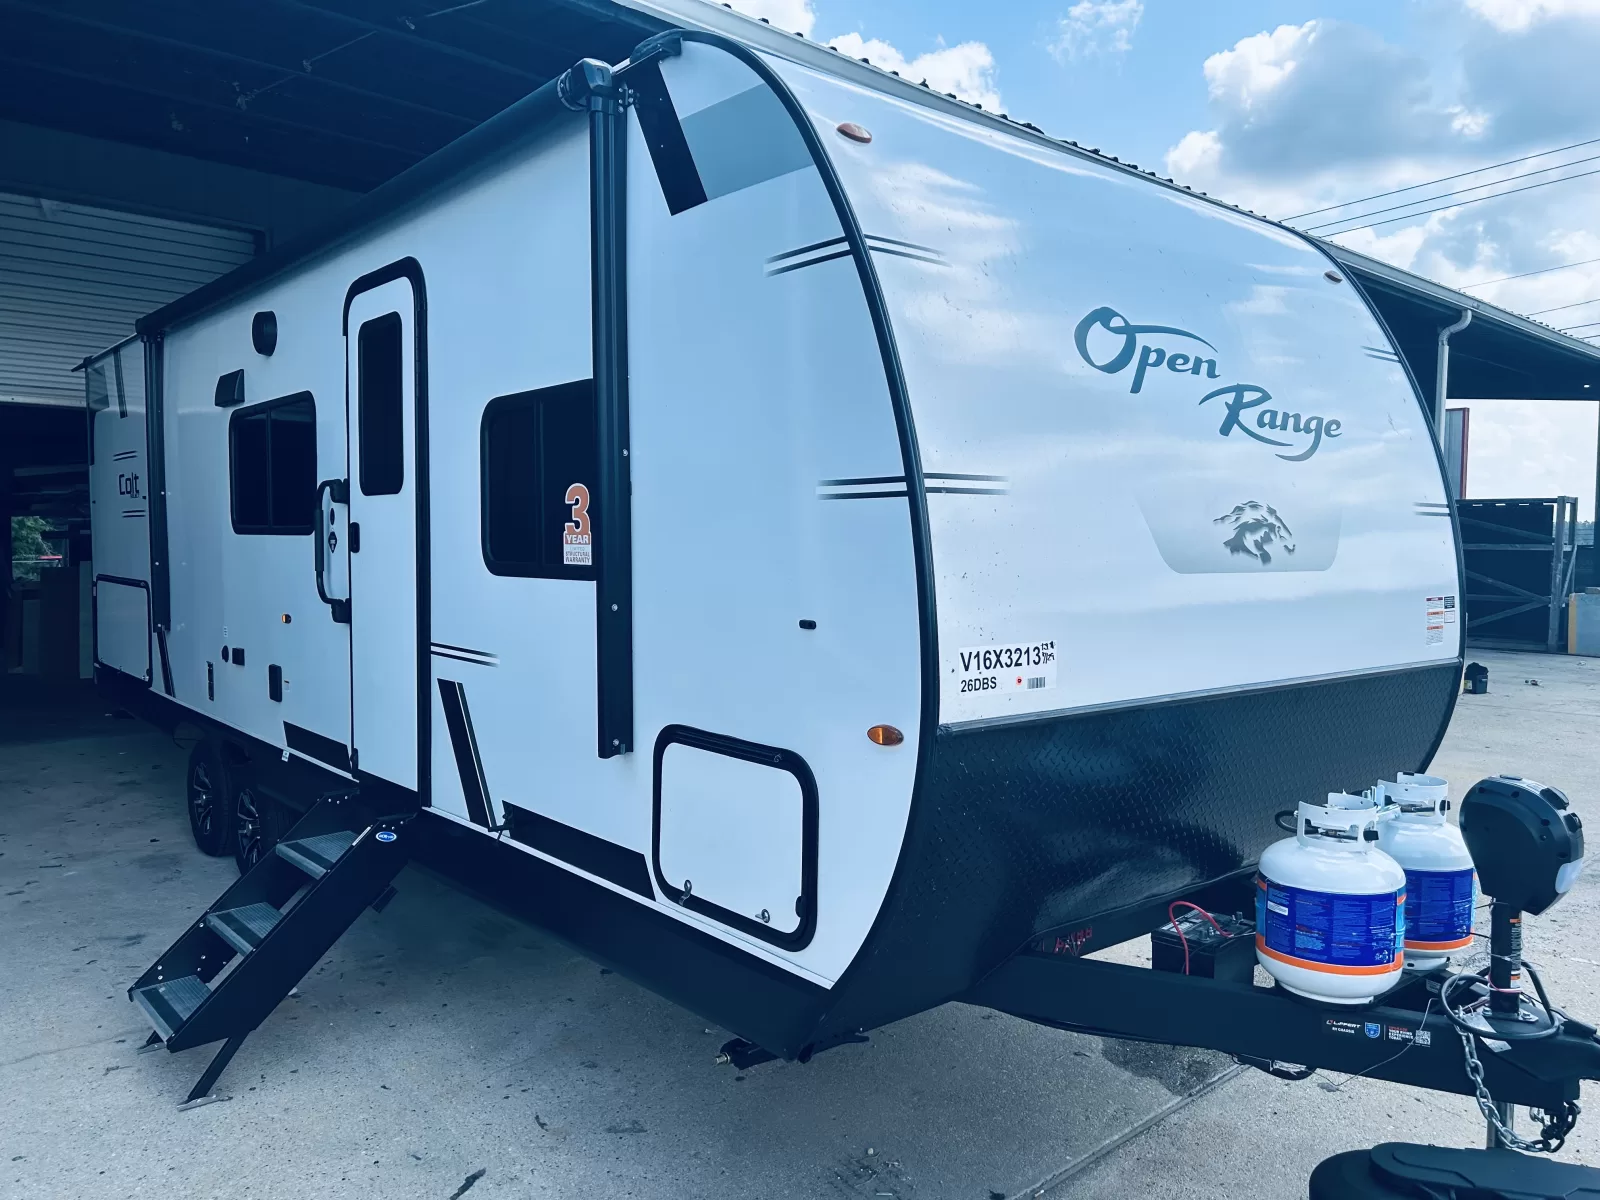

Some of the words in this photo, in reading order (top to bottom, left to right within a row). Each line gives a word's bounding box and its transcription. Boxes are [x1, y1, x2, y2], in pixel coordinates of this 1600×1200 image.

[1074, 306, 1221, 394] Open
[1198, 383, 1342, 461] Range
[118, 472, 140, 495] Colt
[565, 483, 590, 534] 3
[566, 534, 590, 544] YEAR
[960, 646, 1041, 672] V16X3213
[960, 676, 997, 693] 26DBS
